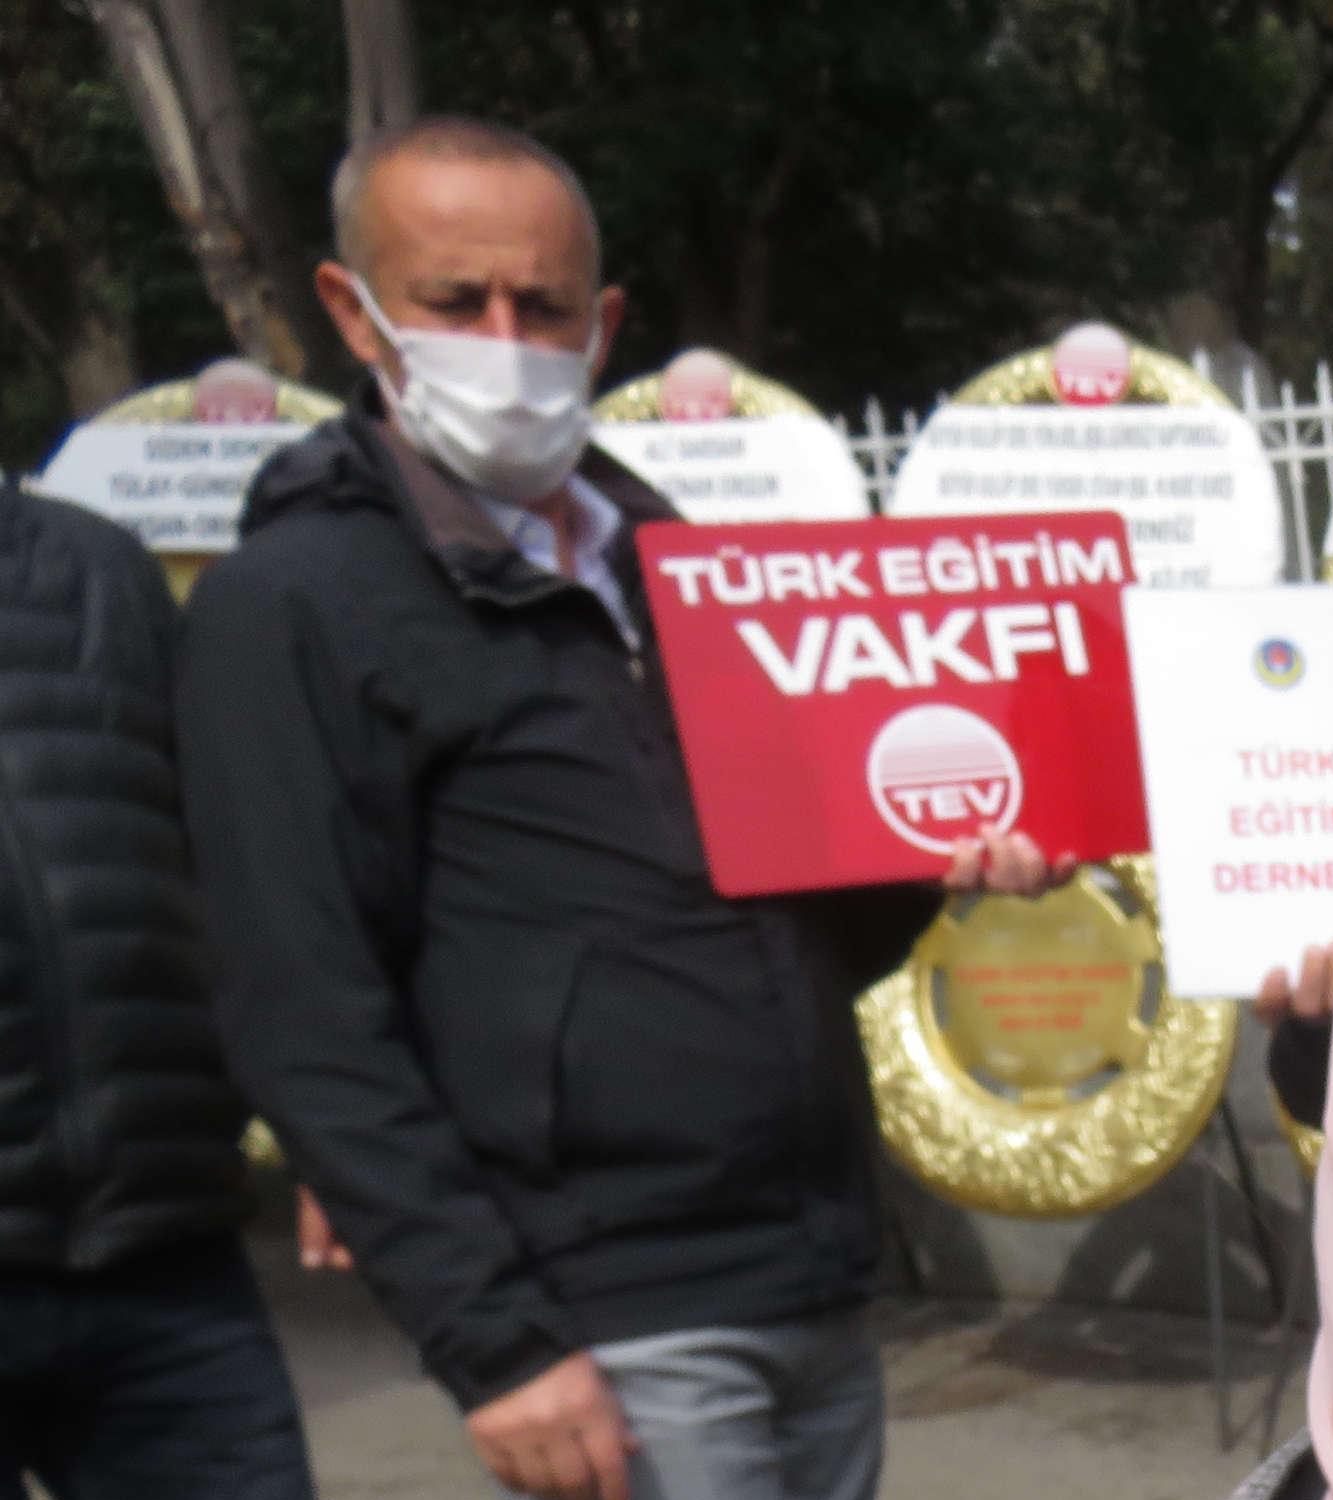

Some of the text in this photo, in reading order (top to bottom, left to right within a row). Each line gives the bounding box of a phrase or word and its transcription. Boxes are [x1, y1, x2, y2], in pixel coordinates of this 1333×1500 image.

[659, 544, 872, 606] TÜRK
[877, 529, 1124, 597] EĞİTİM
[735, 600, 1090, 696] VAKFI
[892, 780, 1004, 823] TEV
